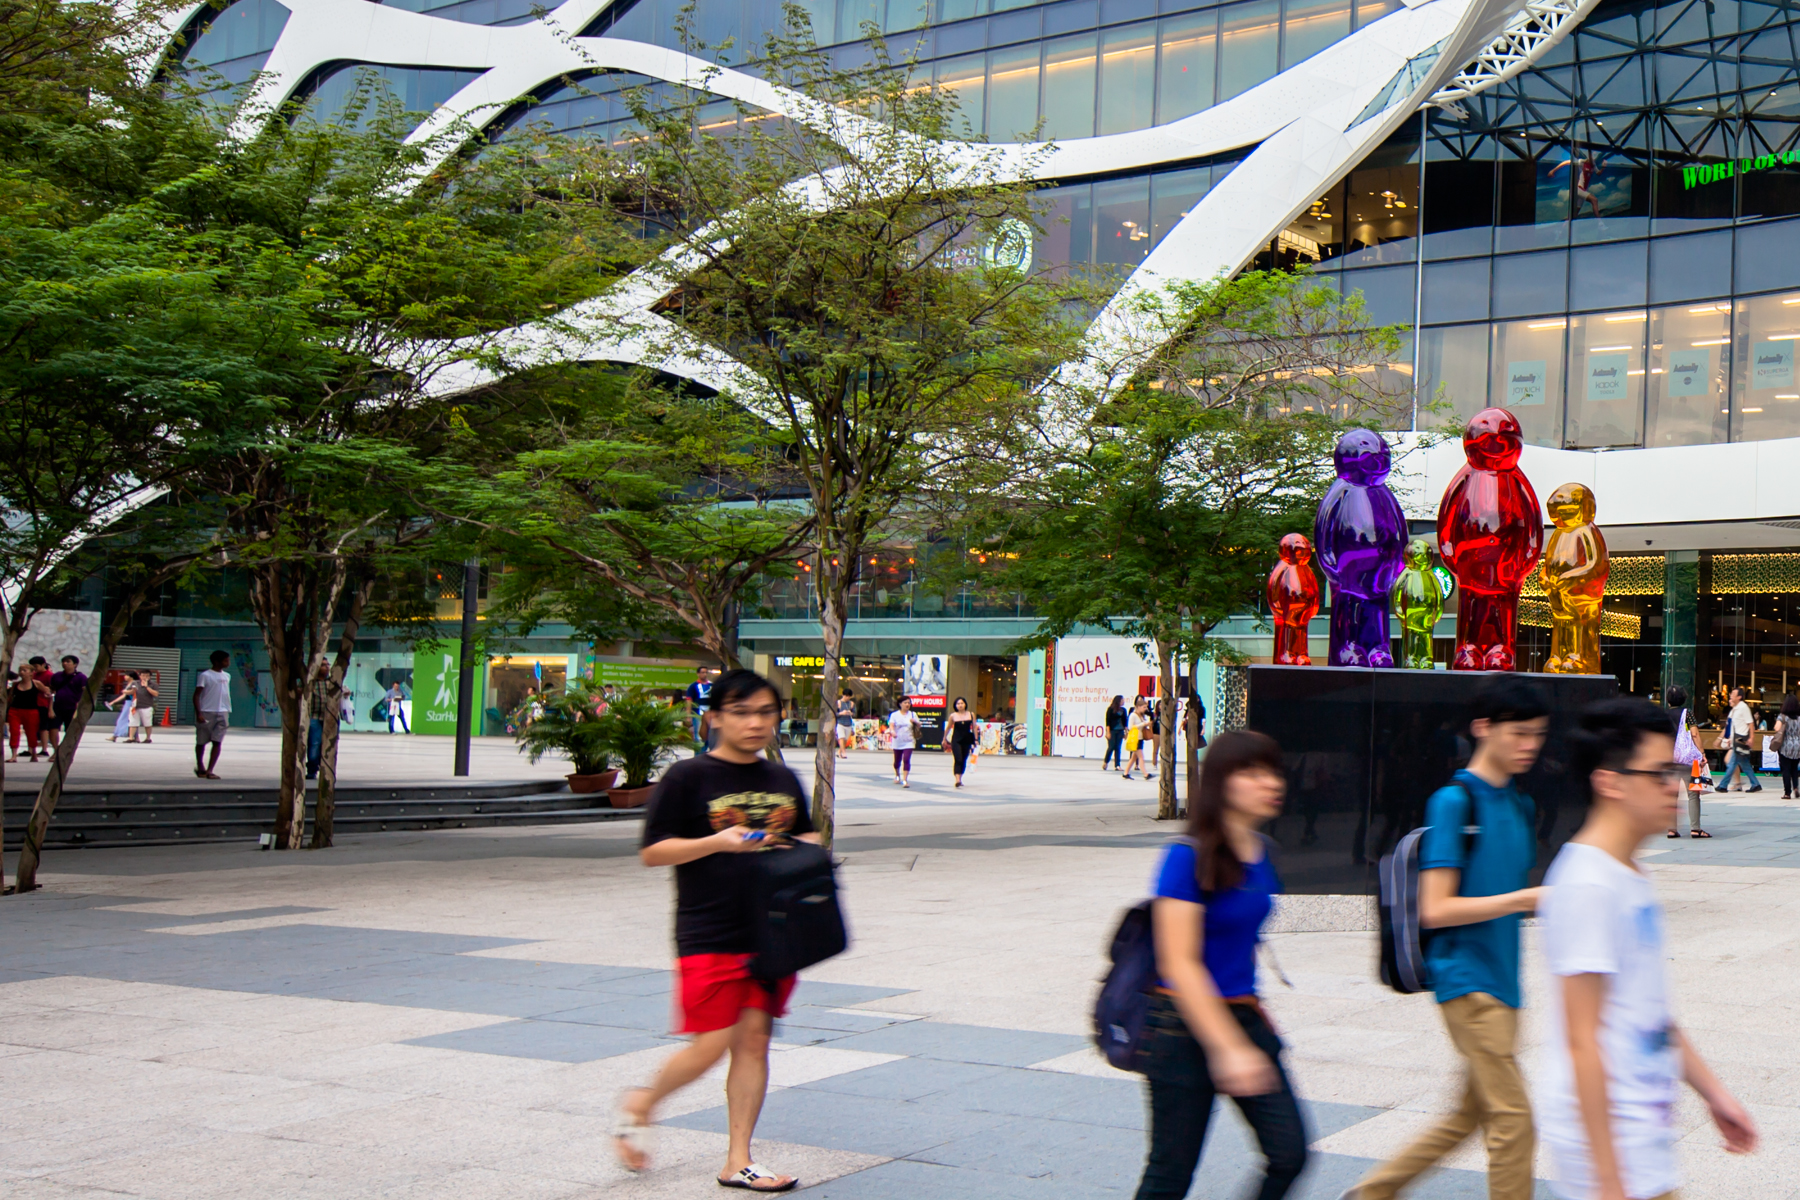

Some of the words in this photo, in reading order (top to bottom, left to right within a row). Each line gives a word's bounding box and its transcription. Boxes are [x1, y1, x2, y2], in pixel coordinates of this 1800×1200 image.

[1754, 152, 1779, 171] OF
[1596, 380, 1619, 389] kapok
[776, 656, 793, 666] THE
[794, 656, 815, 667] CAFE
[1062, 652, 1111, 681] HOLA!
[1072, 687, 1084, 695] you
[1086, 686, 1109, 696] hungry
[911, 698, 923, 706] APPY
[924, 698, 944, 706] HOURS
[1058, 695, 1067, 703] for
[1093, 695, 1101, 703] of
[426, 710, 458, 722] StarHu
[1056, 725, 1104, 738] MUCHO
